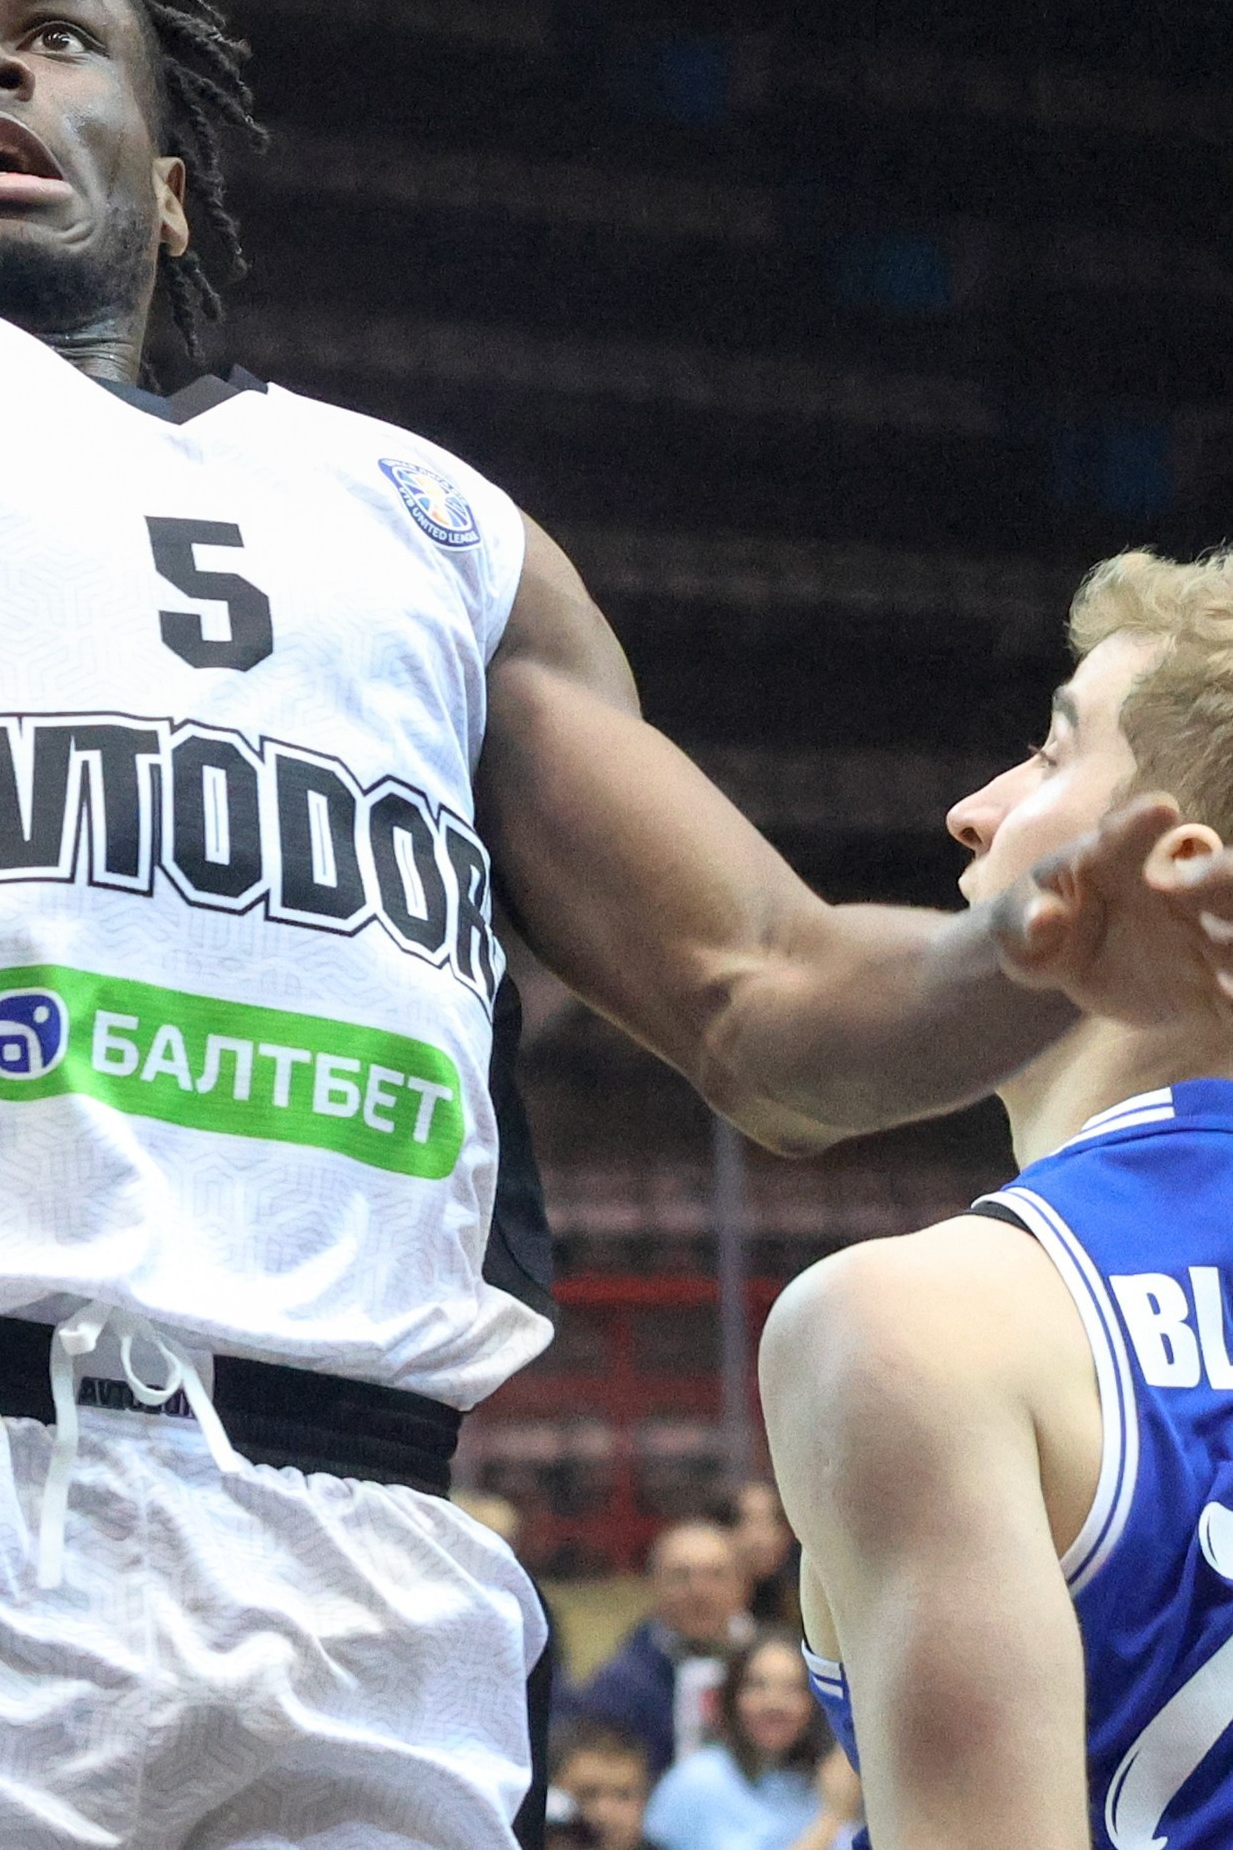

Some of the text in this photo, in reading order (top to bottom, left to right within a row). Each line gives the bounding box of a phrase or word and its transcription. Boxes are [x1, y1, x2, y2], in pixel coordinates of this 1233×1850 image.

[412, 506, 448, 541] UNITED
[145, 516, 274, 673] 5
[90, 1008, 453, 1144] БАЛТБЕТ
